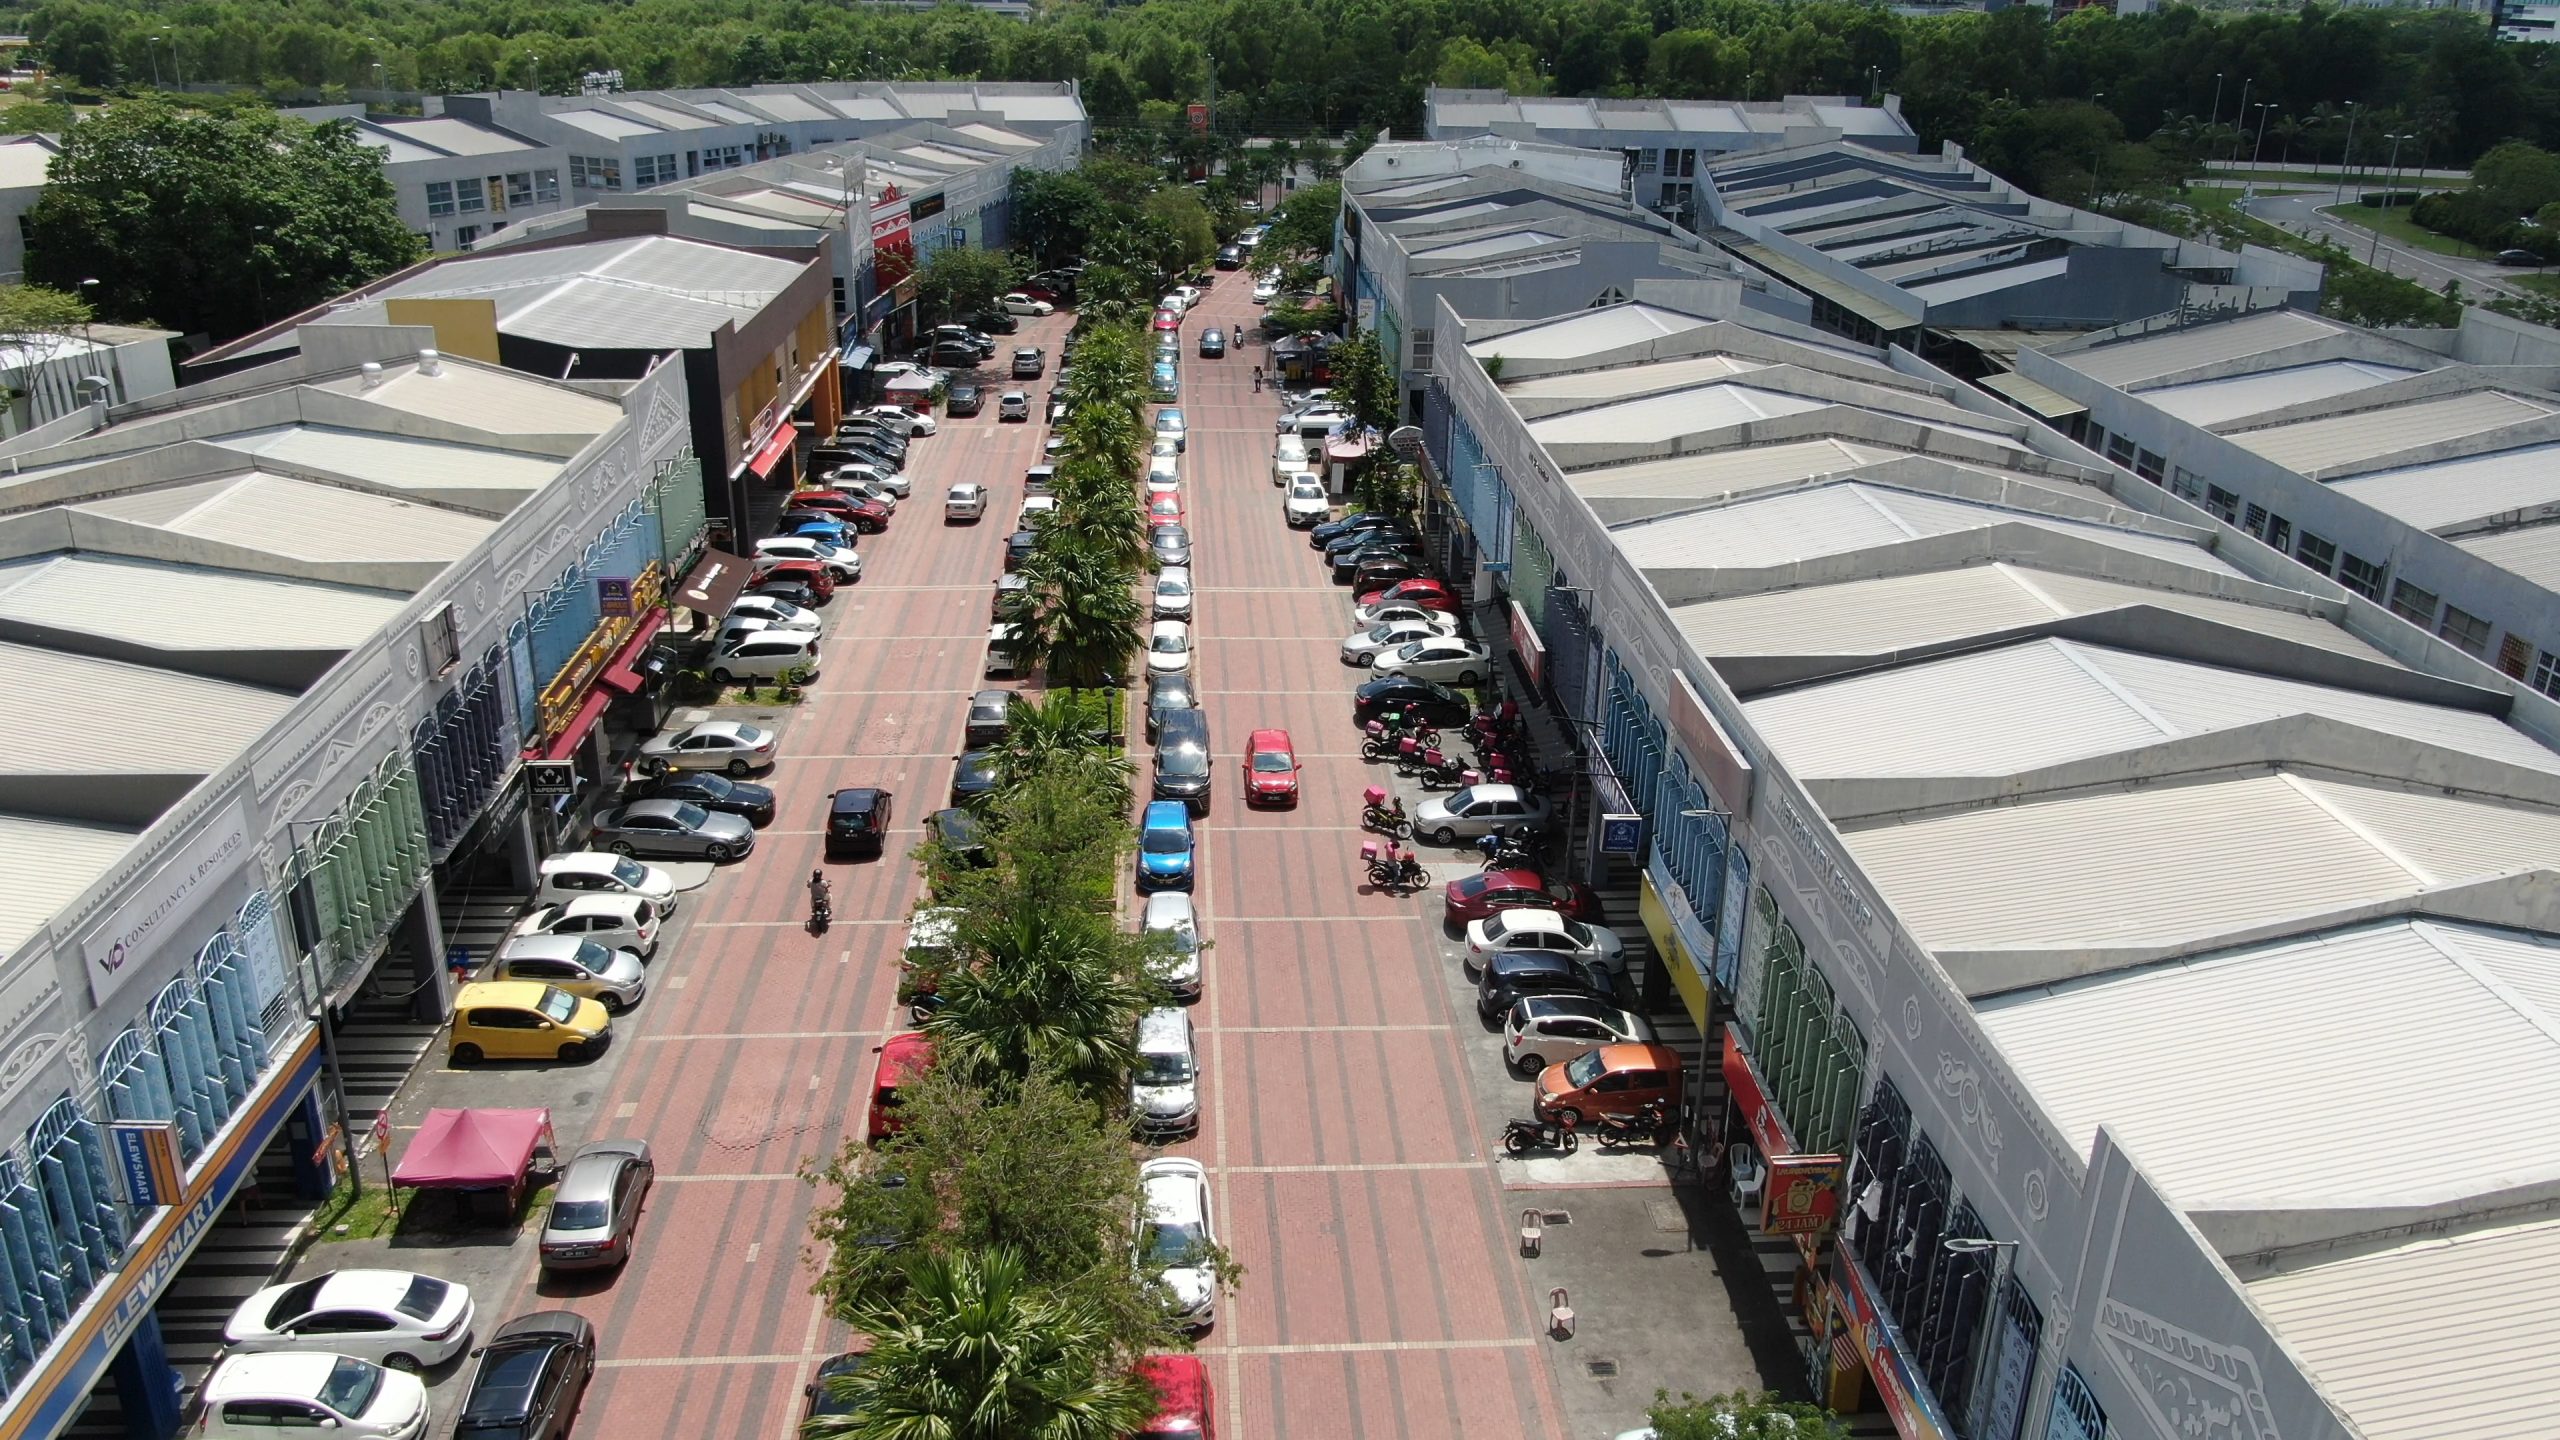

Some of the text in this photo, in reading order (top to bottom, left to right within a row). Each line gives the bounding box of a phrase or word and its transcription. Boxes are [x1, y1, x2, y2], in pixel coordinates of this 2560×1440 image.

[125, 882, 189, 948] CONSULTANCY
[190, 874, 197, 887] &
[198, 831, 242, 878] RESOURCES
[126, 1132, 149, 1201] ELEWSMART
[102, 1186, 215, 1349] ELEWSMART
[1779, 1217, 1819, 1230] 24 JAM
